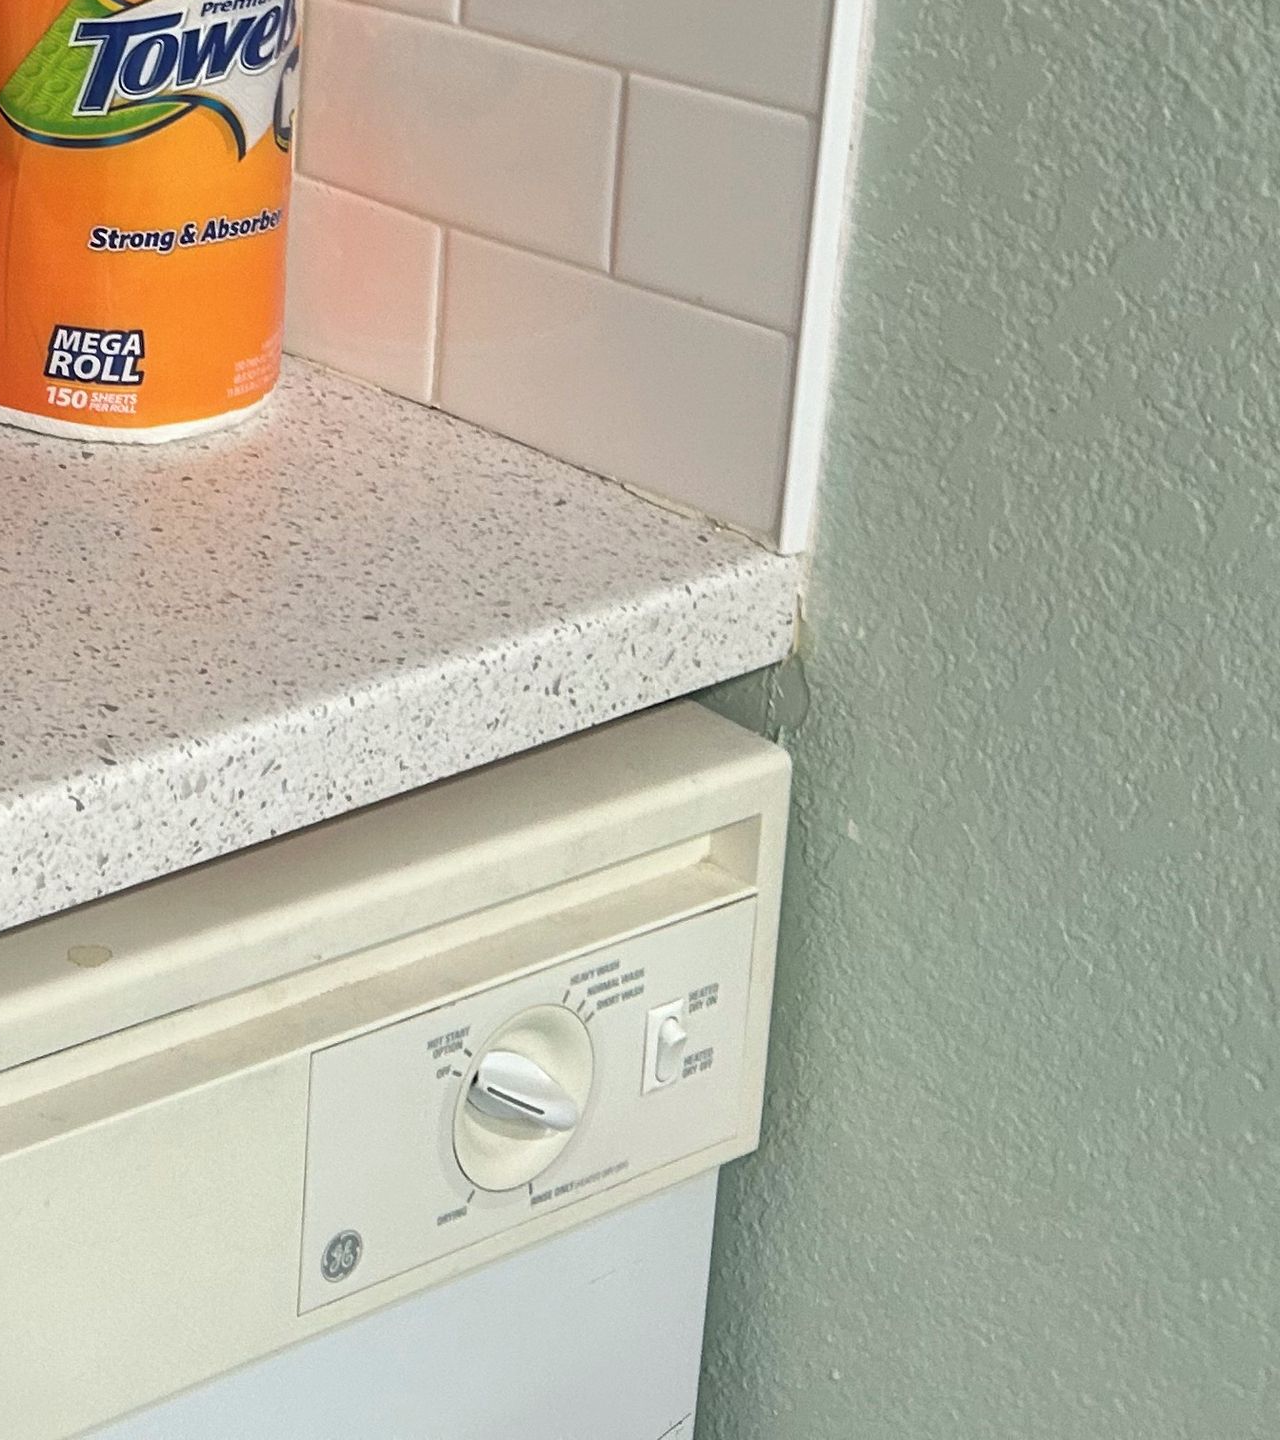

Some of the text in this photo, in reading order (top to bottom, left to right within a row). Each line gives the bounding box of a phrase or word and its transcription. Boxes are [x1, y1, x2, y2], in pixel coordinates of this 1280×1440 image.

[89, 227, 175, 252] Strong
[179, 223, 197, 245] &
[52, 328, 141, 356] MEGA
[48, 350, 140, 382] ROLL
[46, 385, 138, 410] 150 SHEETS
